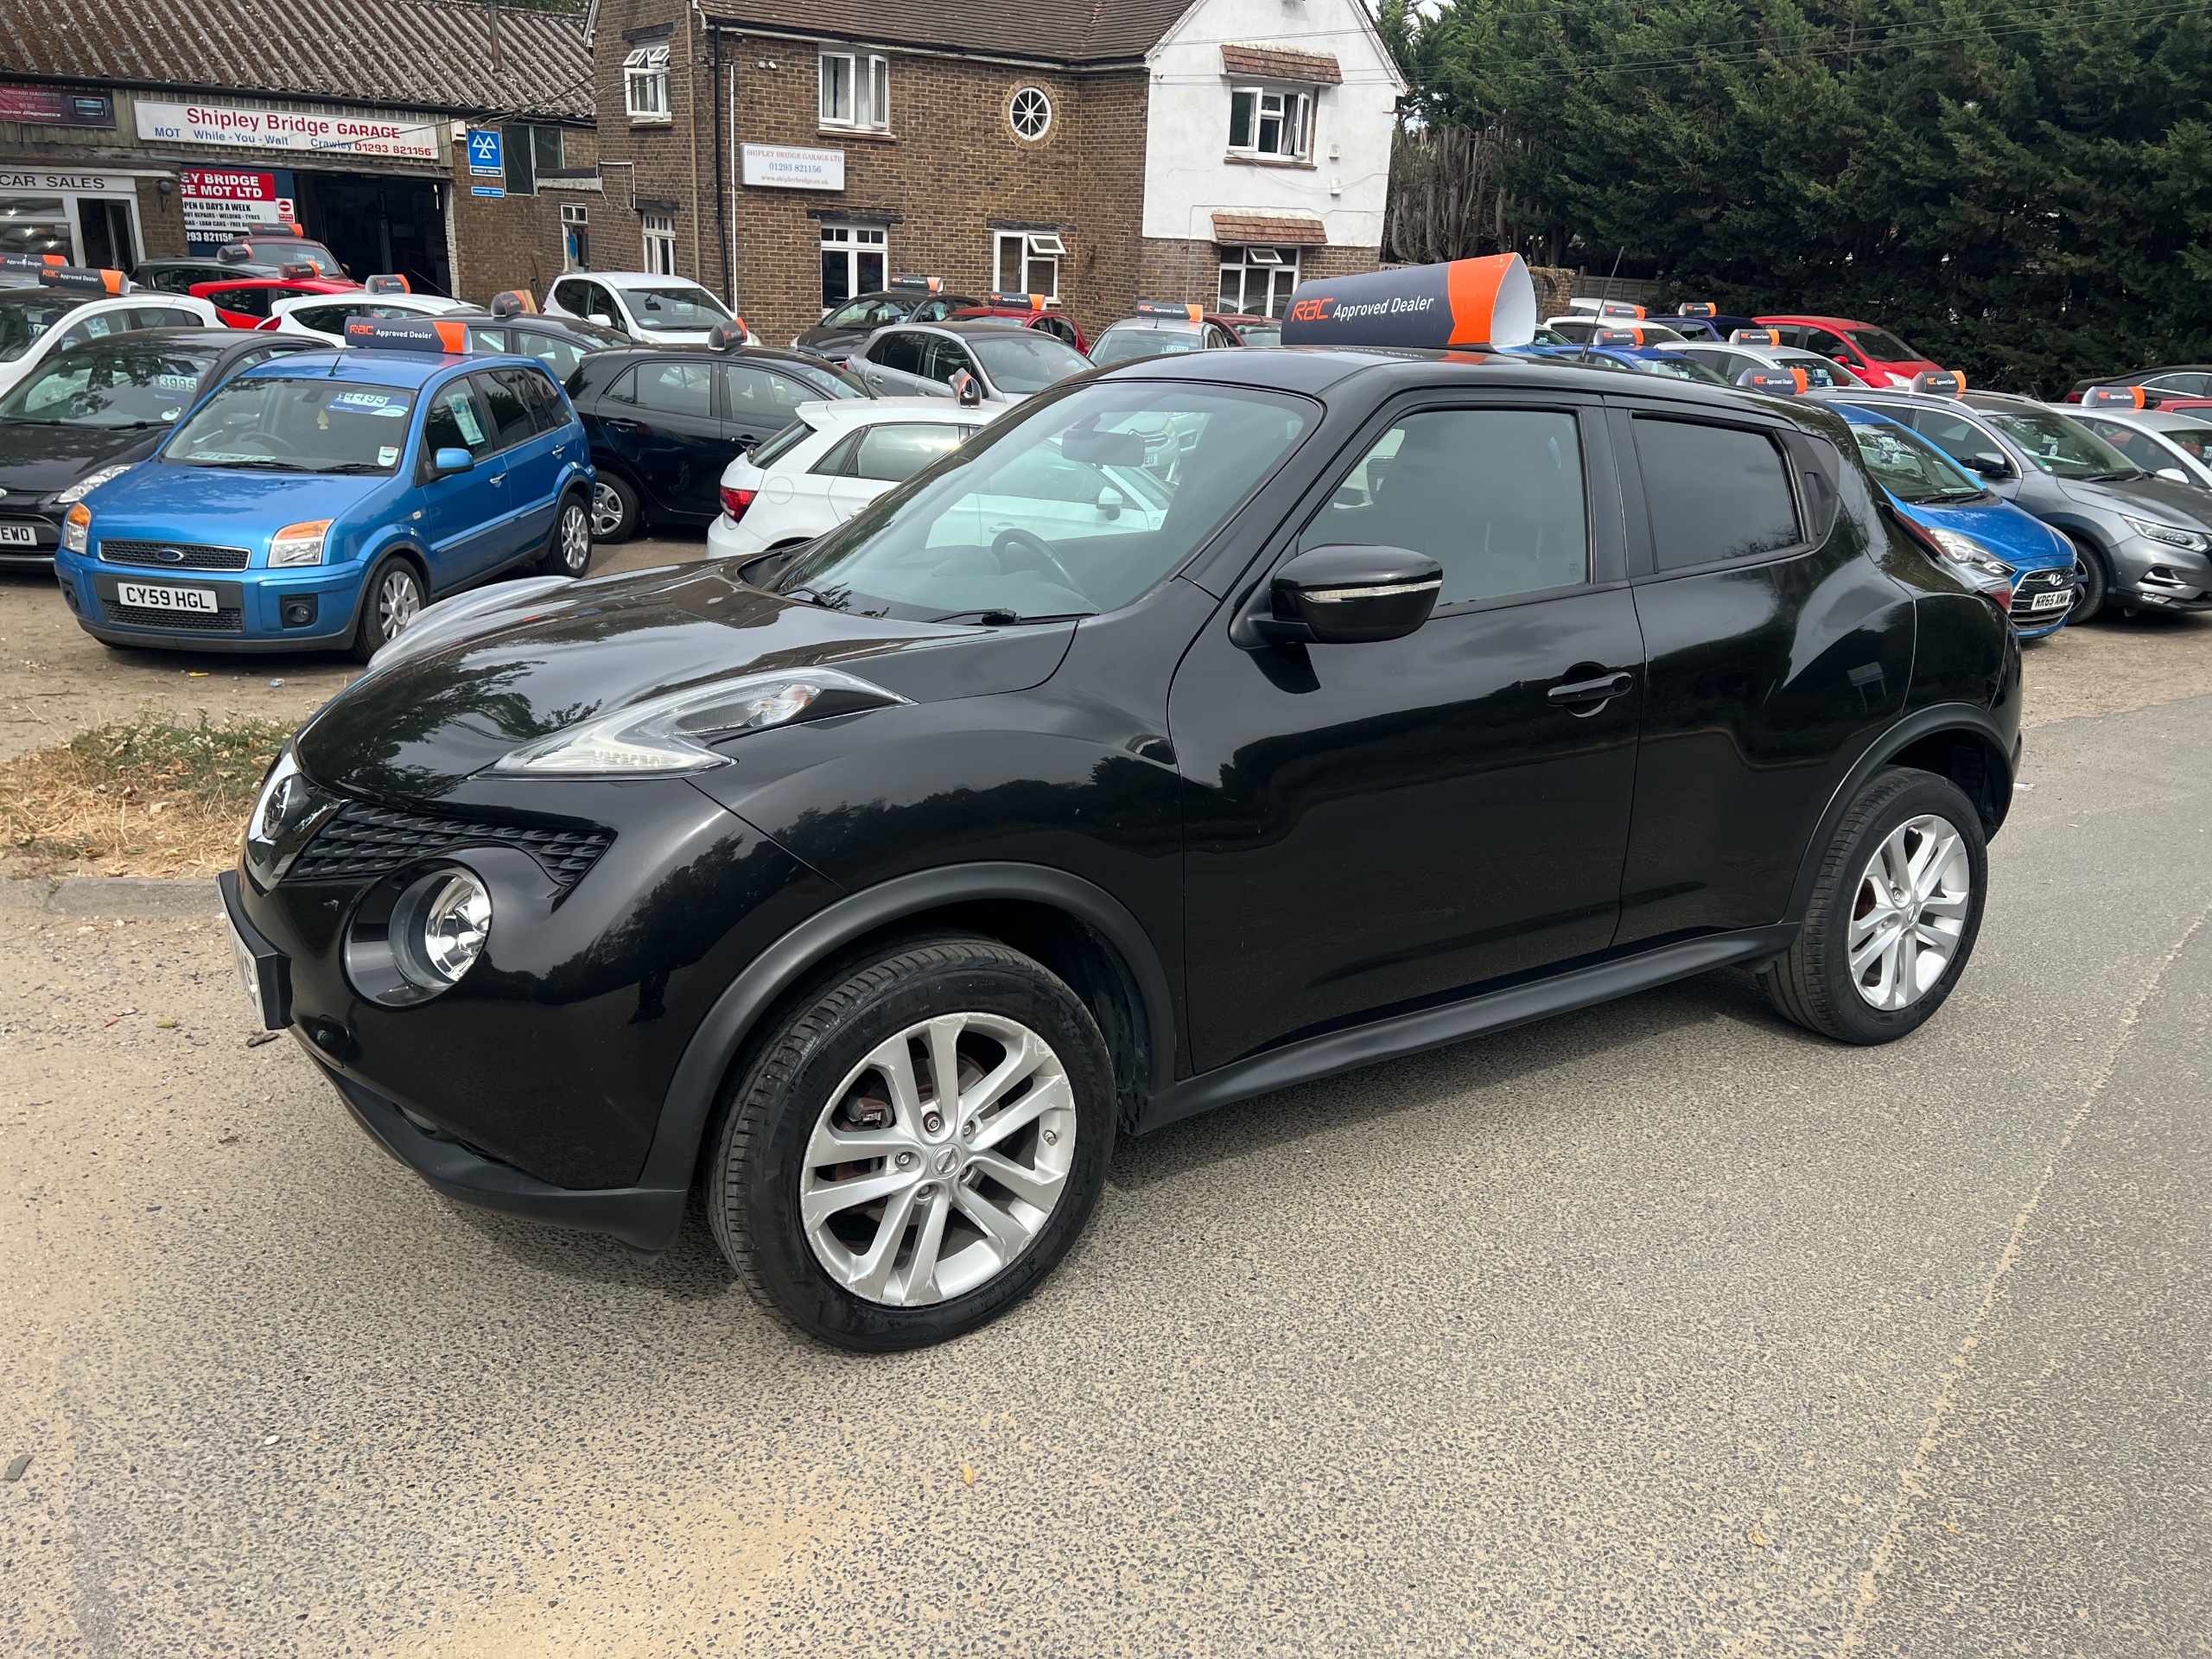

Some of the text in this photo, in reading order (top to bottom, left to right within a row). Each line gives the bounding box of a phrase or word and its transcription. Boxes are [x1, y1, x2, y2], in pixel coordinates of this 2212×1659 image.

[187, 107, 401, 139] Shipley Bridge GARAGE
[155, 127, 181, 138] MOT
[194, 130, 226, 141] While
[234, 132, 257, 143] You
[264, 135, 289, 146] Wait
[310, 137, 432, 156] Crawley 01293 821156
[746, 149, 776, 157] SHIPLEY
[776, 151, 801, 160] BRIDGE
[802, 153, 830, 162] GARAGE
[769, 162, 823, 174] 01293 821156
[0, 175, 105, 189] CAR SALES
[204, 173, 260, 187] BRIDGE
[760, 175, 830, 186] www.shipleybridge.co.uk
[200, 184, 232, 197] MOT
[236, 186, 263, 198] LTD
[183, 201, 198, 210] PEN
[206, 201, 225, 211] DAYS
[231, 203, 252, 213] WEEK
[60, 272, 82, 282] Approved
[1291, 295, 1434, 322] RAC Approved Dealer
[349, 324, 433, 340] RAC Approved Dealer
[1, 526, 30, 542] EWO
[125, 587, 211, 609] CY59 HGL
